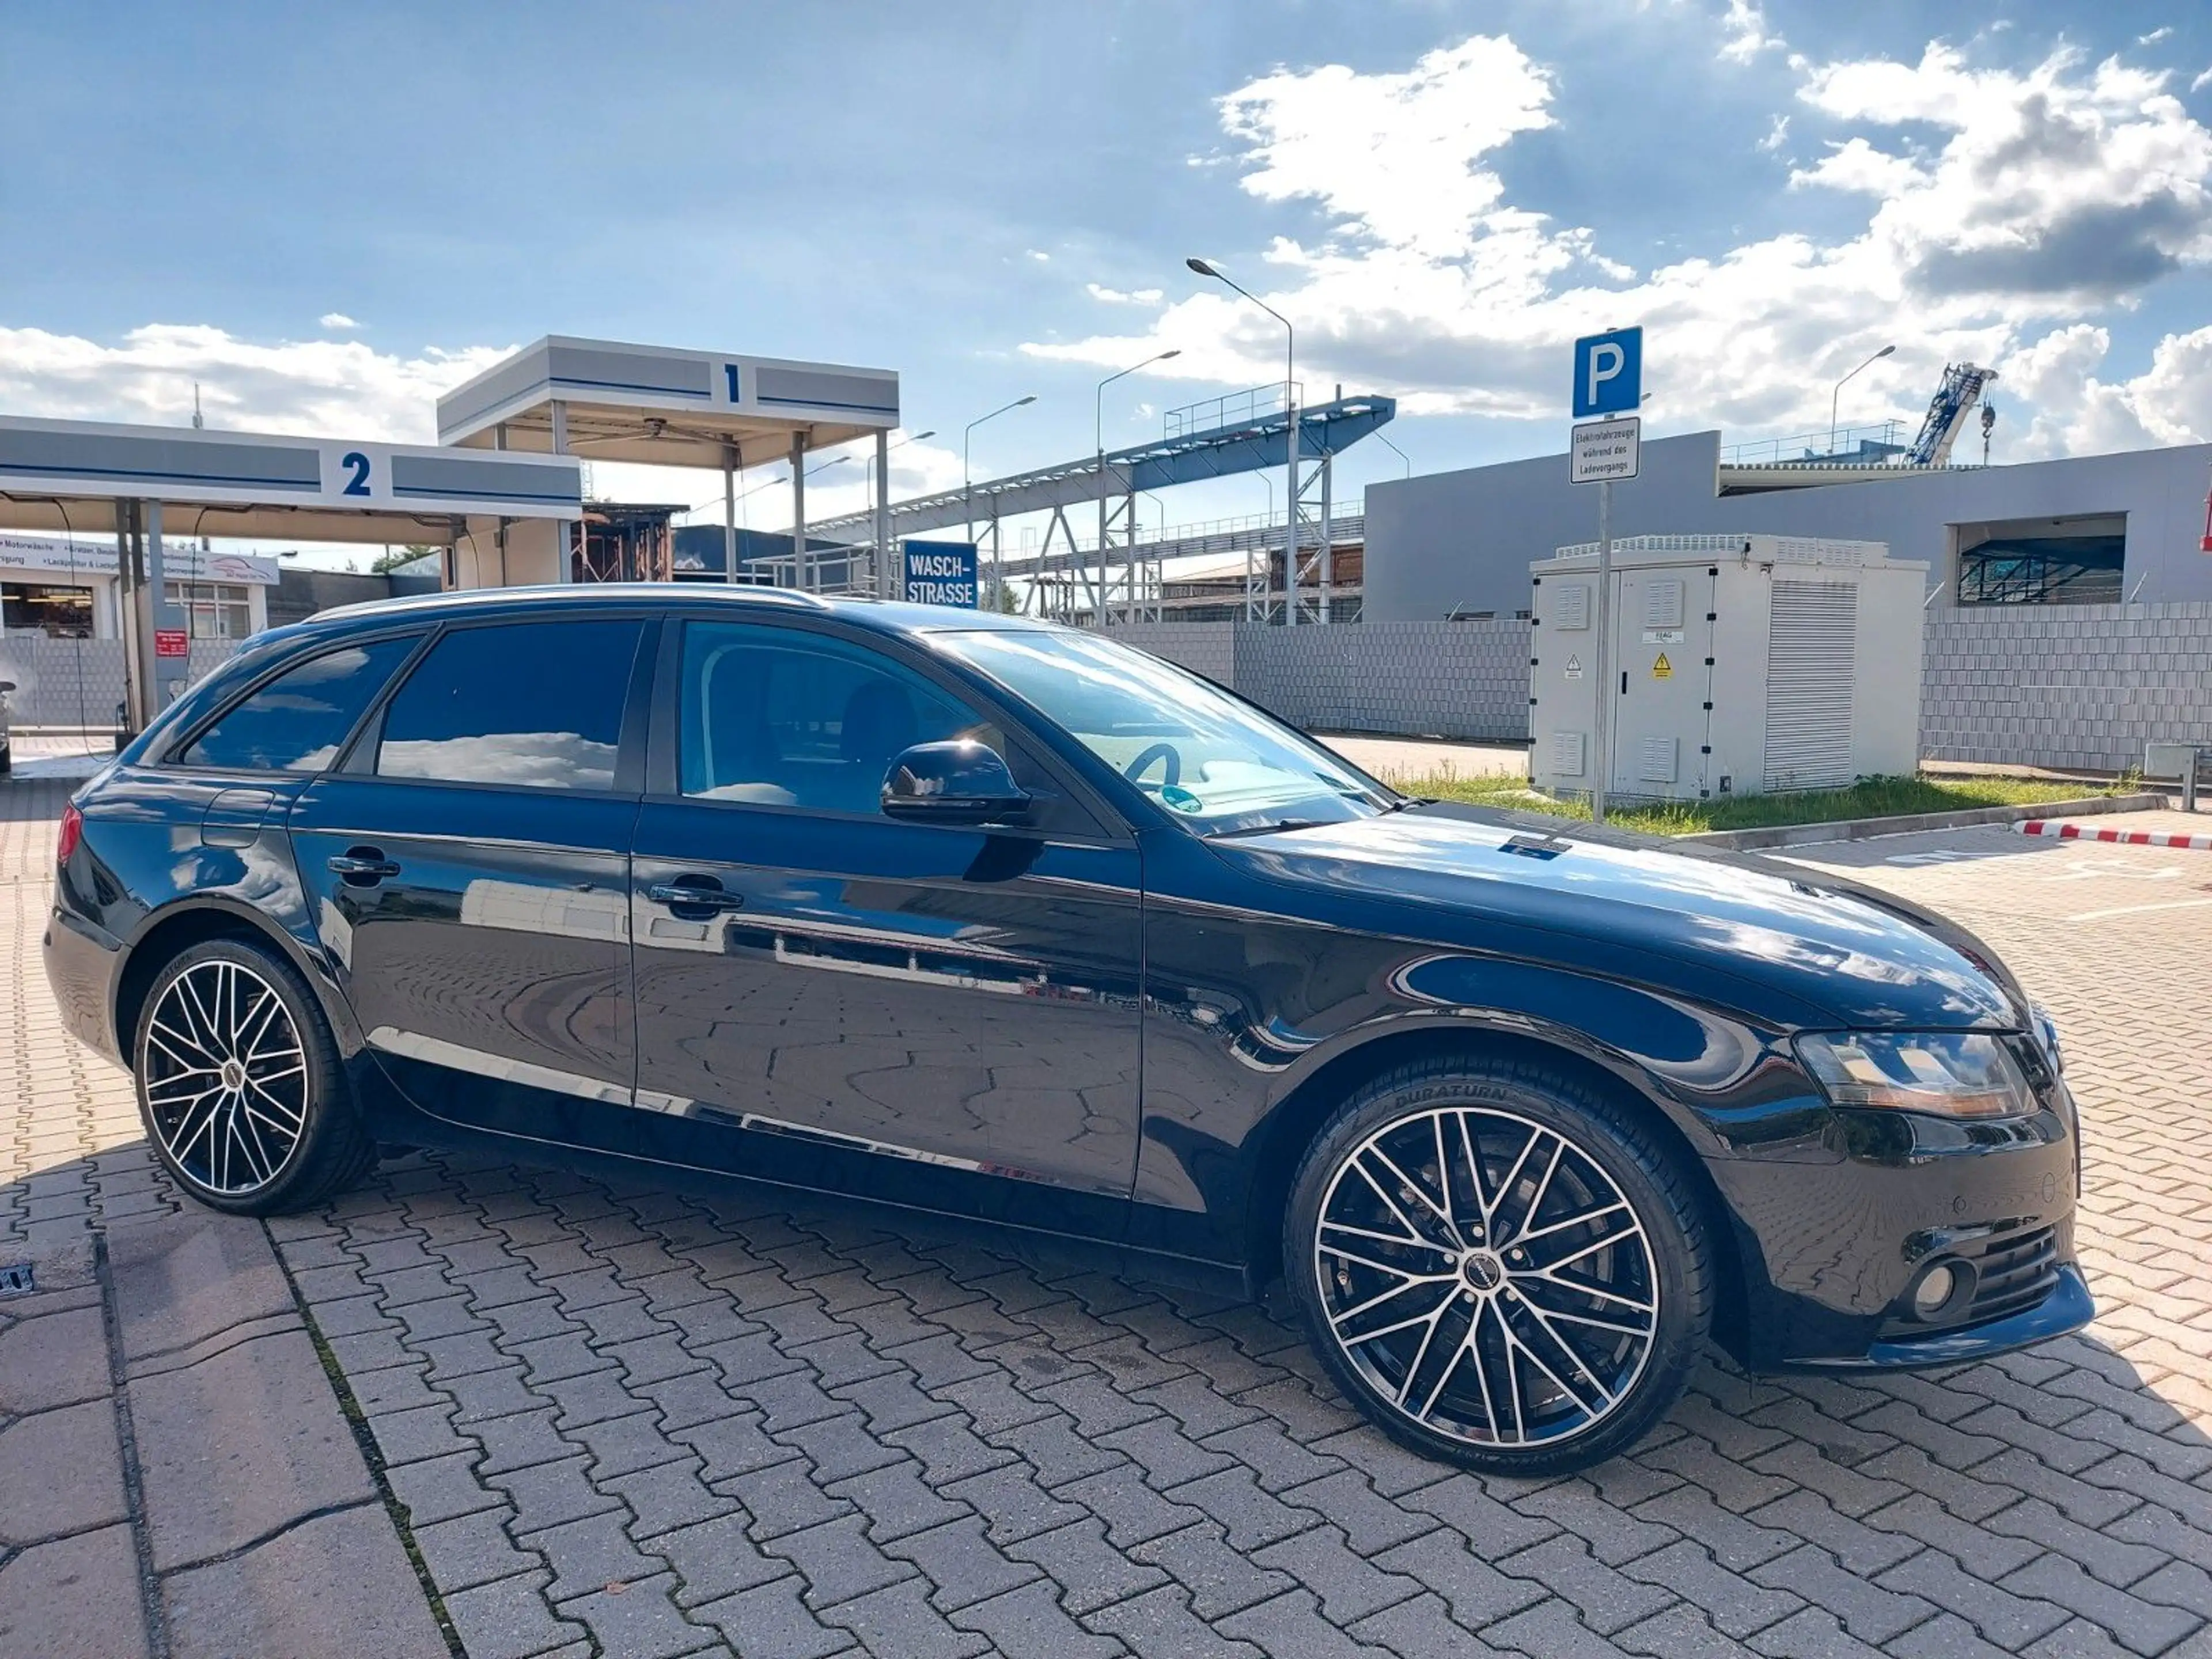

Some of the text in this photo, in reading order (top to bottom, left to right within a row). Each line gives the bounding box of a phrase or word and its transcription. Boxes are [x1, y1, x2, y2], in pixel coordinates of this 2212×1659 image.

[724, 363, 739, 403] 1
[1588, 343, 1624, 405] P
[1576, 429, 1635, 443] Elektrofahrzeuge
[1583, 446, 1612, 458] während
[342, 452, 371, 496] 2
[1580, 462, 1628, 475] Ladevorgangs
[910, 555, 971, 577] WASCH-
[908, 581, 974, 604] STRASSE
[1395, 1085, 1509, 1109] DURATURN
